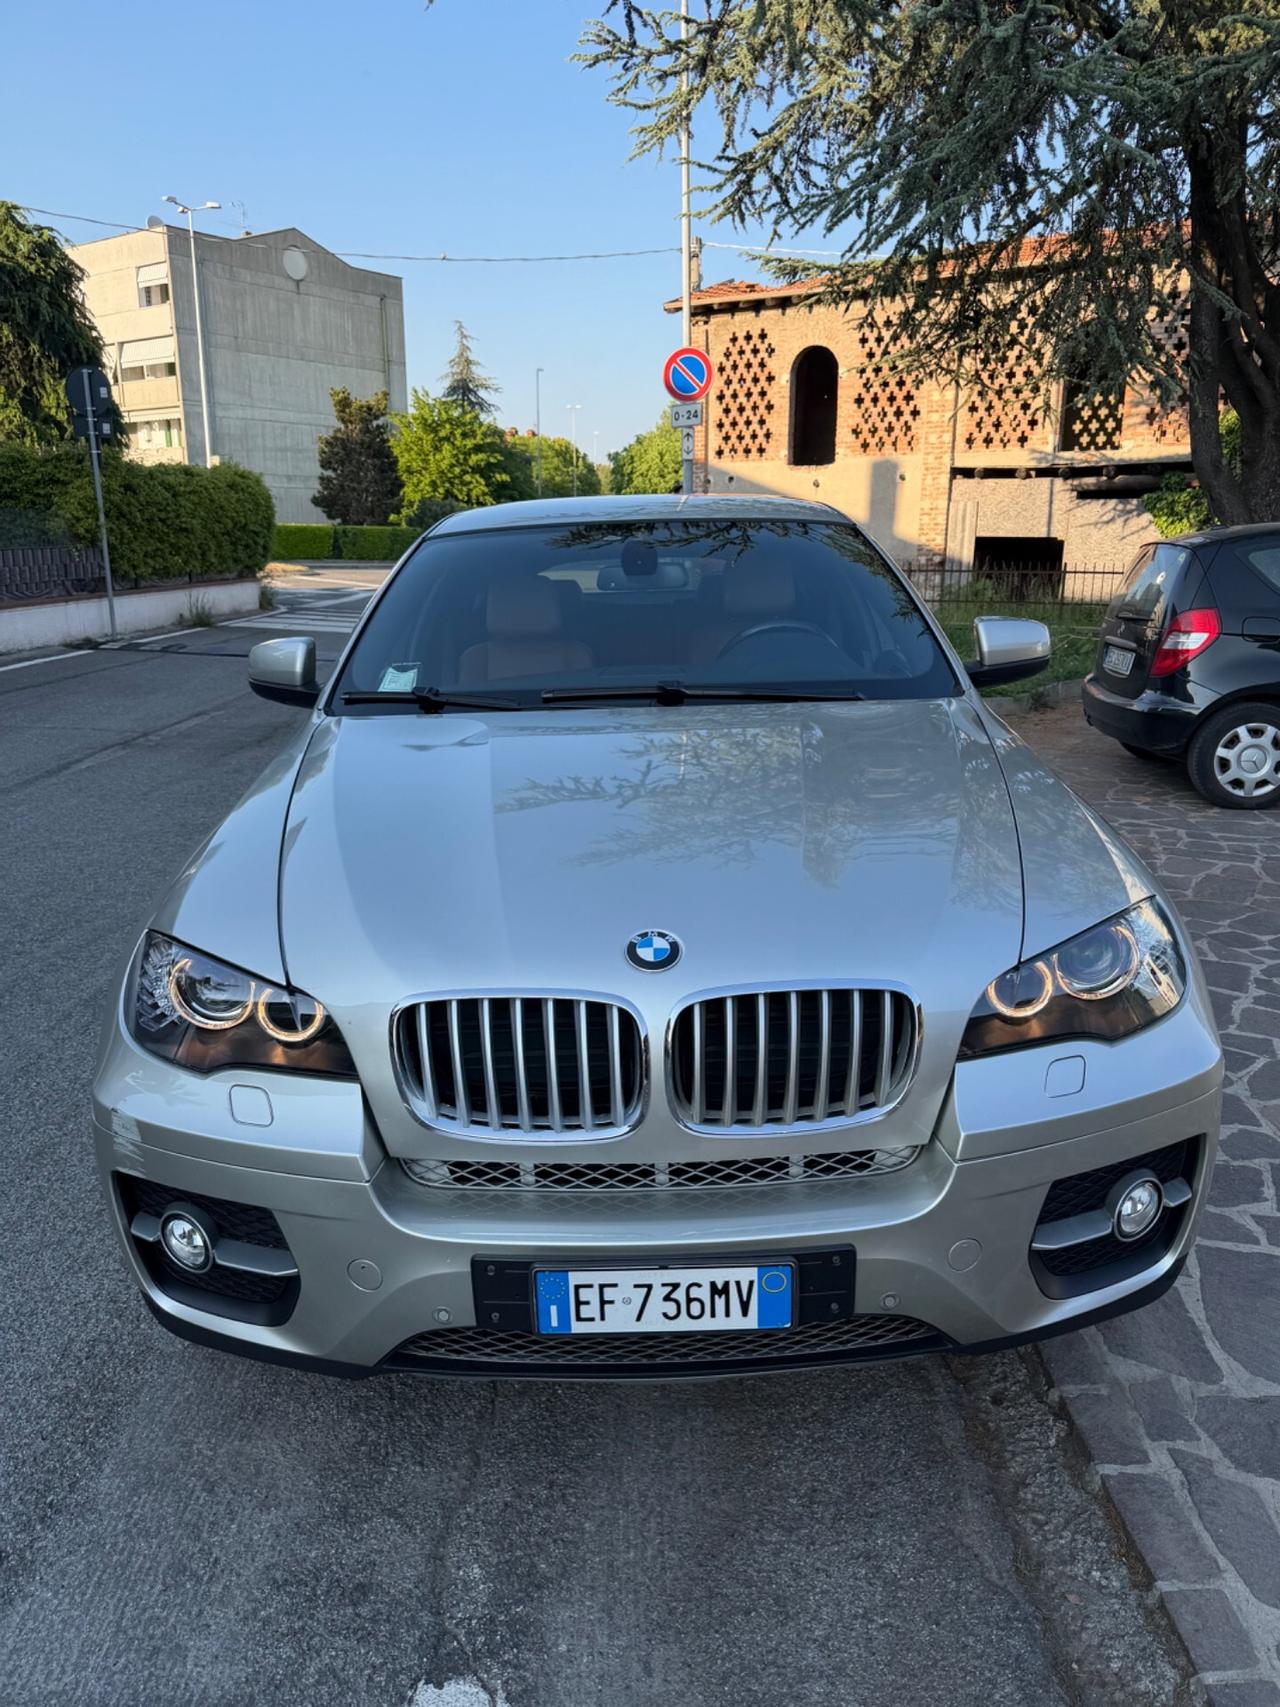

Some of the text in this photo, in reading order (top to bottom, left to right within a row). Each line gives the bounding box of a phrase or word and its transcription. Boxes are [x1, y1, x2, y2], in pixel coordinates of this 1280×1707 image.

[632, 931, 676, 943] BMW
[574, 1280, 755, 1322] EF 736MV
[550, 1305, 558, 1327] I
